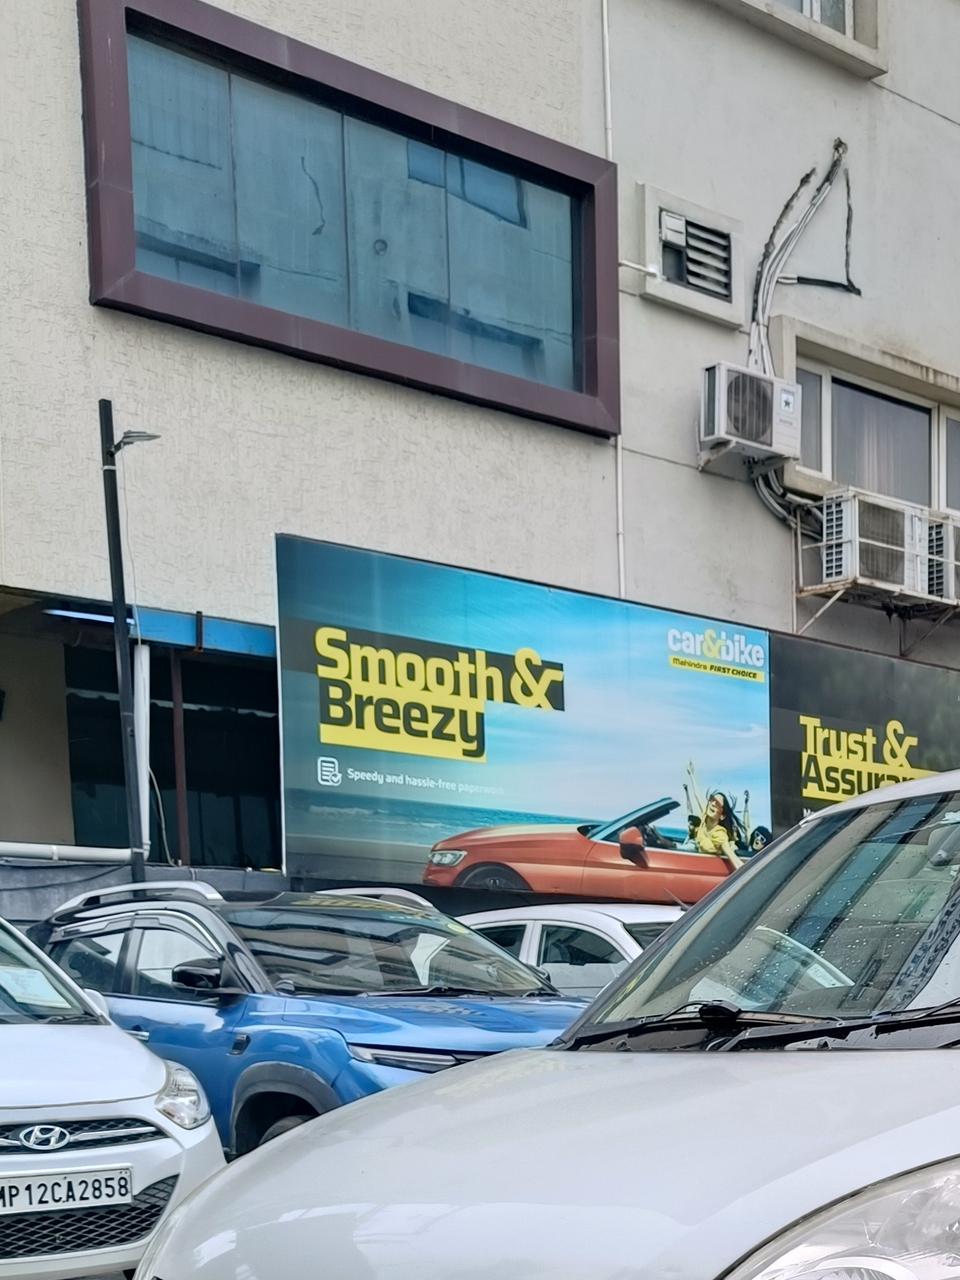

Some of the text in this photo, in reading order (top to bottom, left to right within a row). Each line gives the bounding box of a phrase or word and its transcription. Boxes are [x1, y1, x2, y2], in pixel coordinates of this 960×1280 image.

[313, 626, 564, 711] Smooth &
[667, 628, 765, 667] car&bike
[709, 664, 731, 674] FIRST
[731, 668, 757, 679] CHOICE
[320, 677, 485, 758] Breezy
[800, 715, 918, 769] Trust &
[347, 767, 384, 785] Speedy
[385, 773, 403, 784] and
[405, 775, 456, 791] hassle-free
